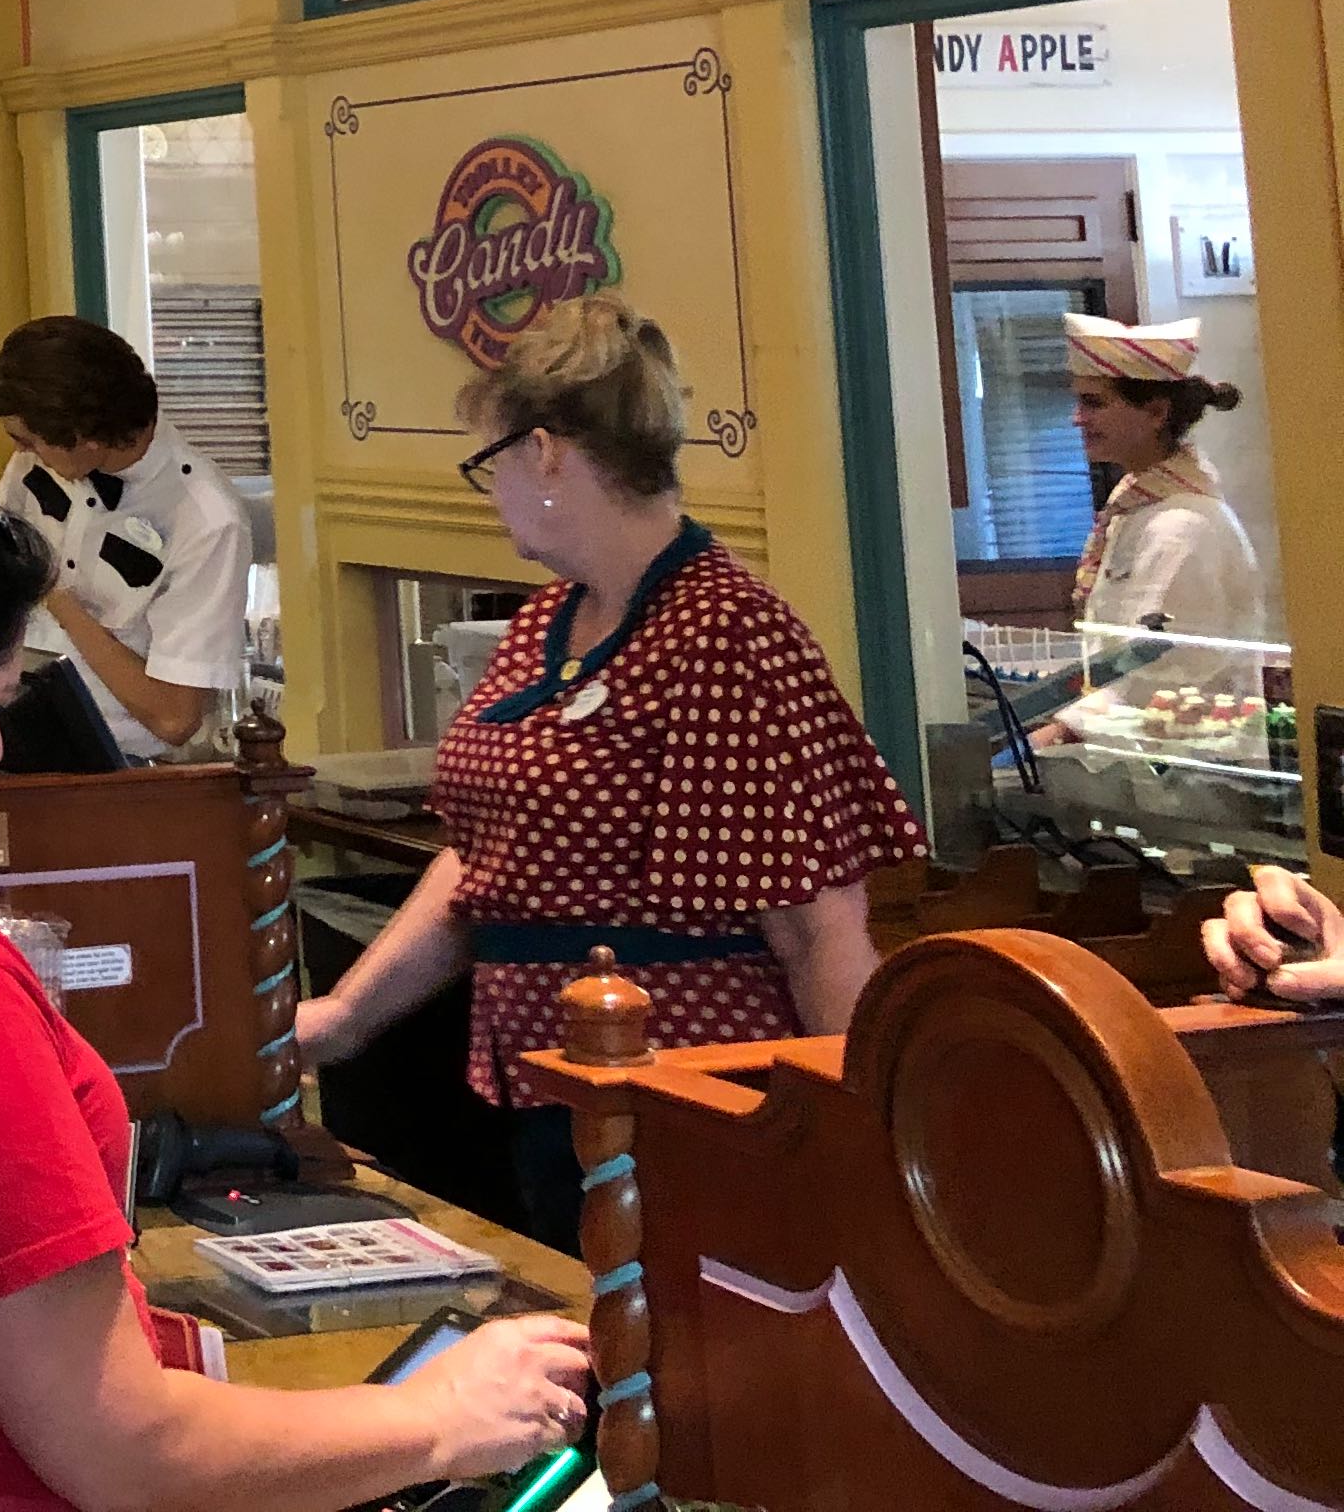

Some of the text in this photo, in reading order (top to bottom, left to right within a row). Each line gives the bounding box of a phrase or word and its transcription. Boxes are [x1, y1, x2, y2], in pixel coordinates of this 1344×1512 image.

[933, 34, 1095, 73] NDY APPLE
[413, 183, 594, 326] Candy
